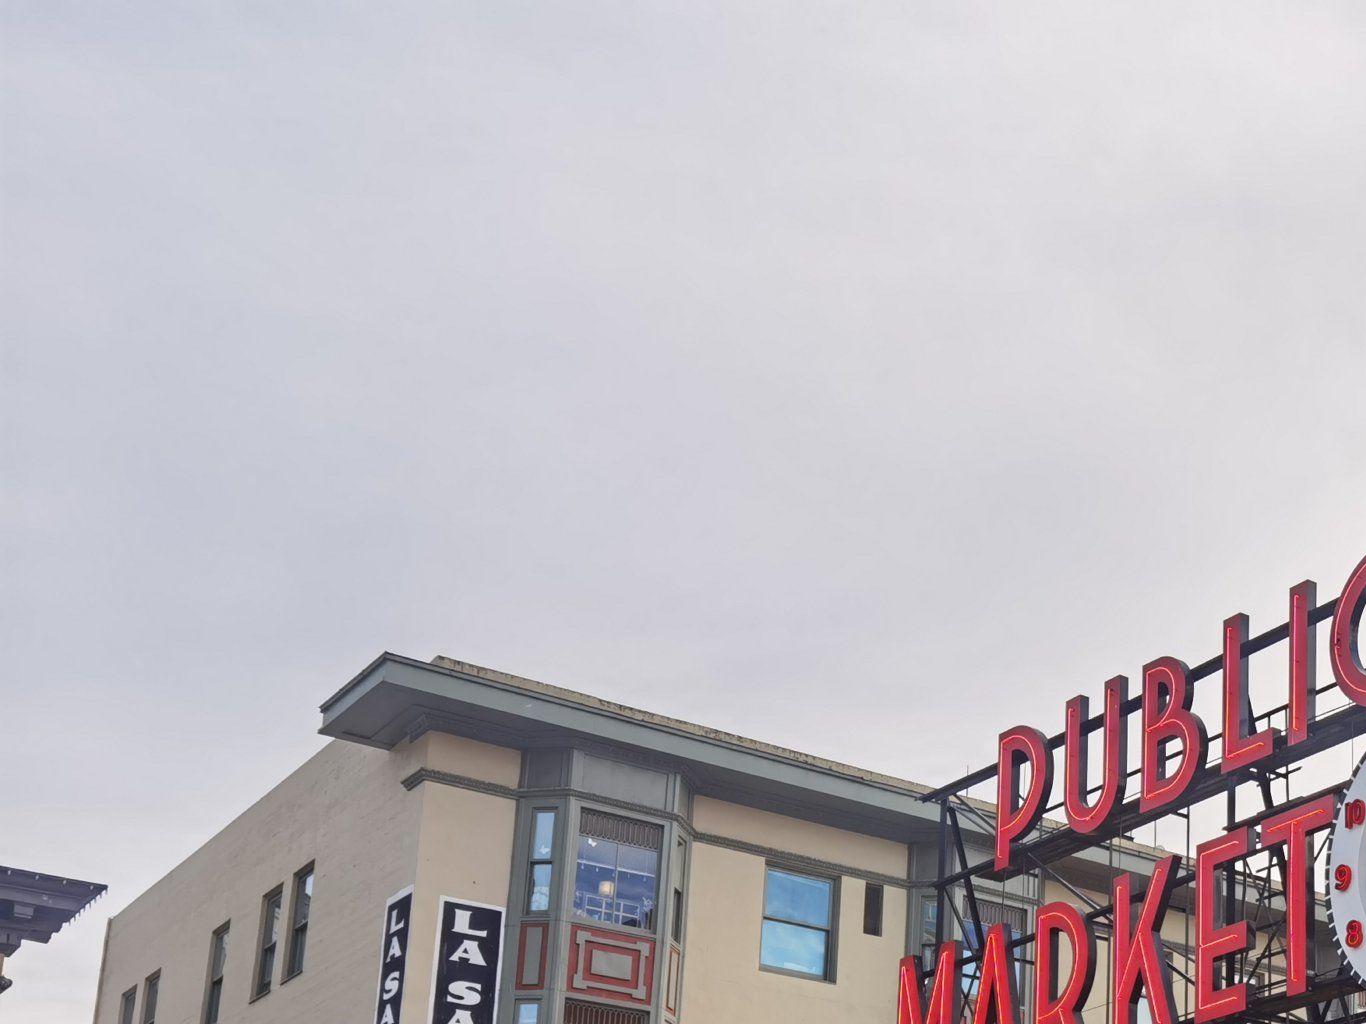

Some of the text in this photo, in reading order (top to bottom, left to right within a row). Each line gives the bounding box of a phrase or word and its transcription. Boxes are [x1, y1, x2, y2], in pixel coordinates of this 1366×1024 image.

[1345, 799, 1366, 829] 10
[1334, 864, 1352, 892] 9
[385, 907, 404, 964] LA
[447, 908, 488, 967] LA
[1345, 920, 1364, 948] 8
